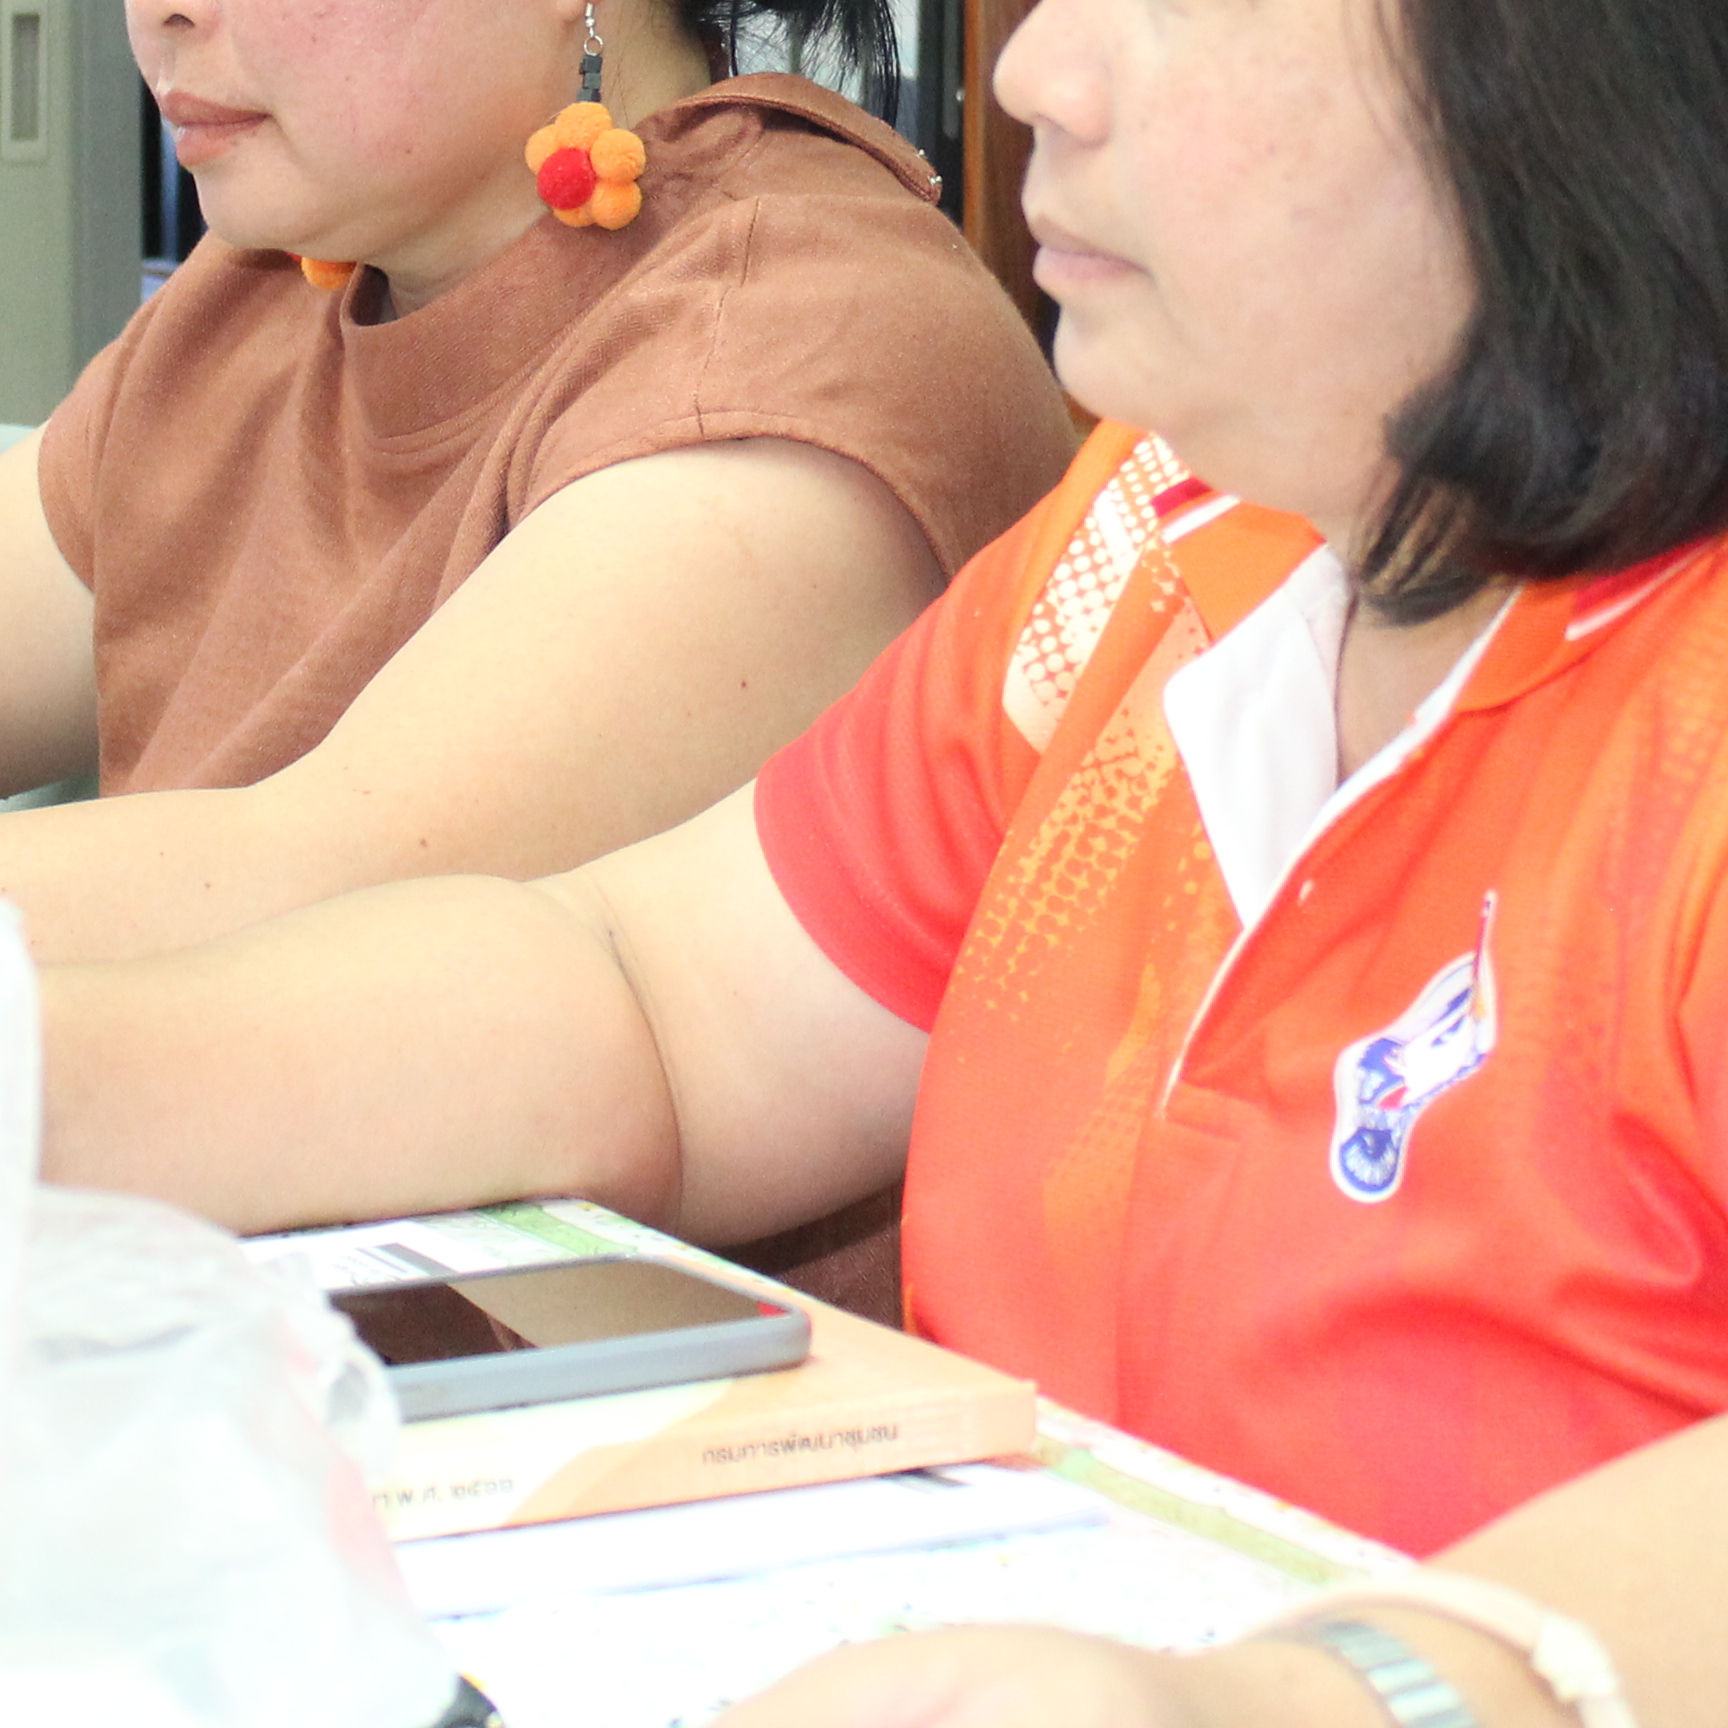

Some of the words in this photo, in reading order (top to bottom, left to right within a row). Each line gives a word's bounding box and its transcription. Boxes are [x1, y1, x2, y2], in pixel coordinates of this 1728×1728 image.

[701, 1424, 900, 1465] กรมการพัฒนาชุมชน
